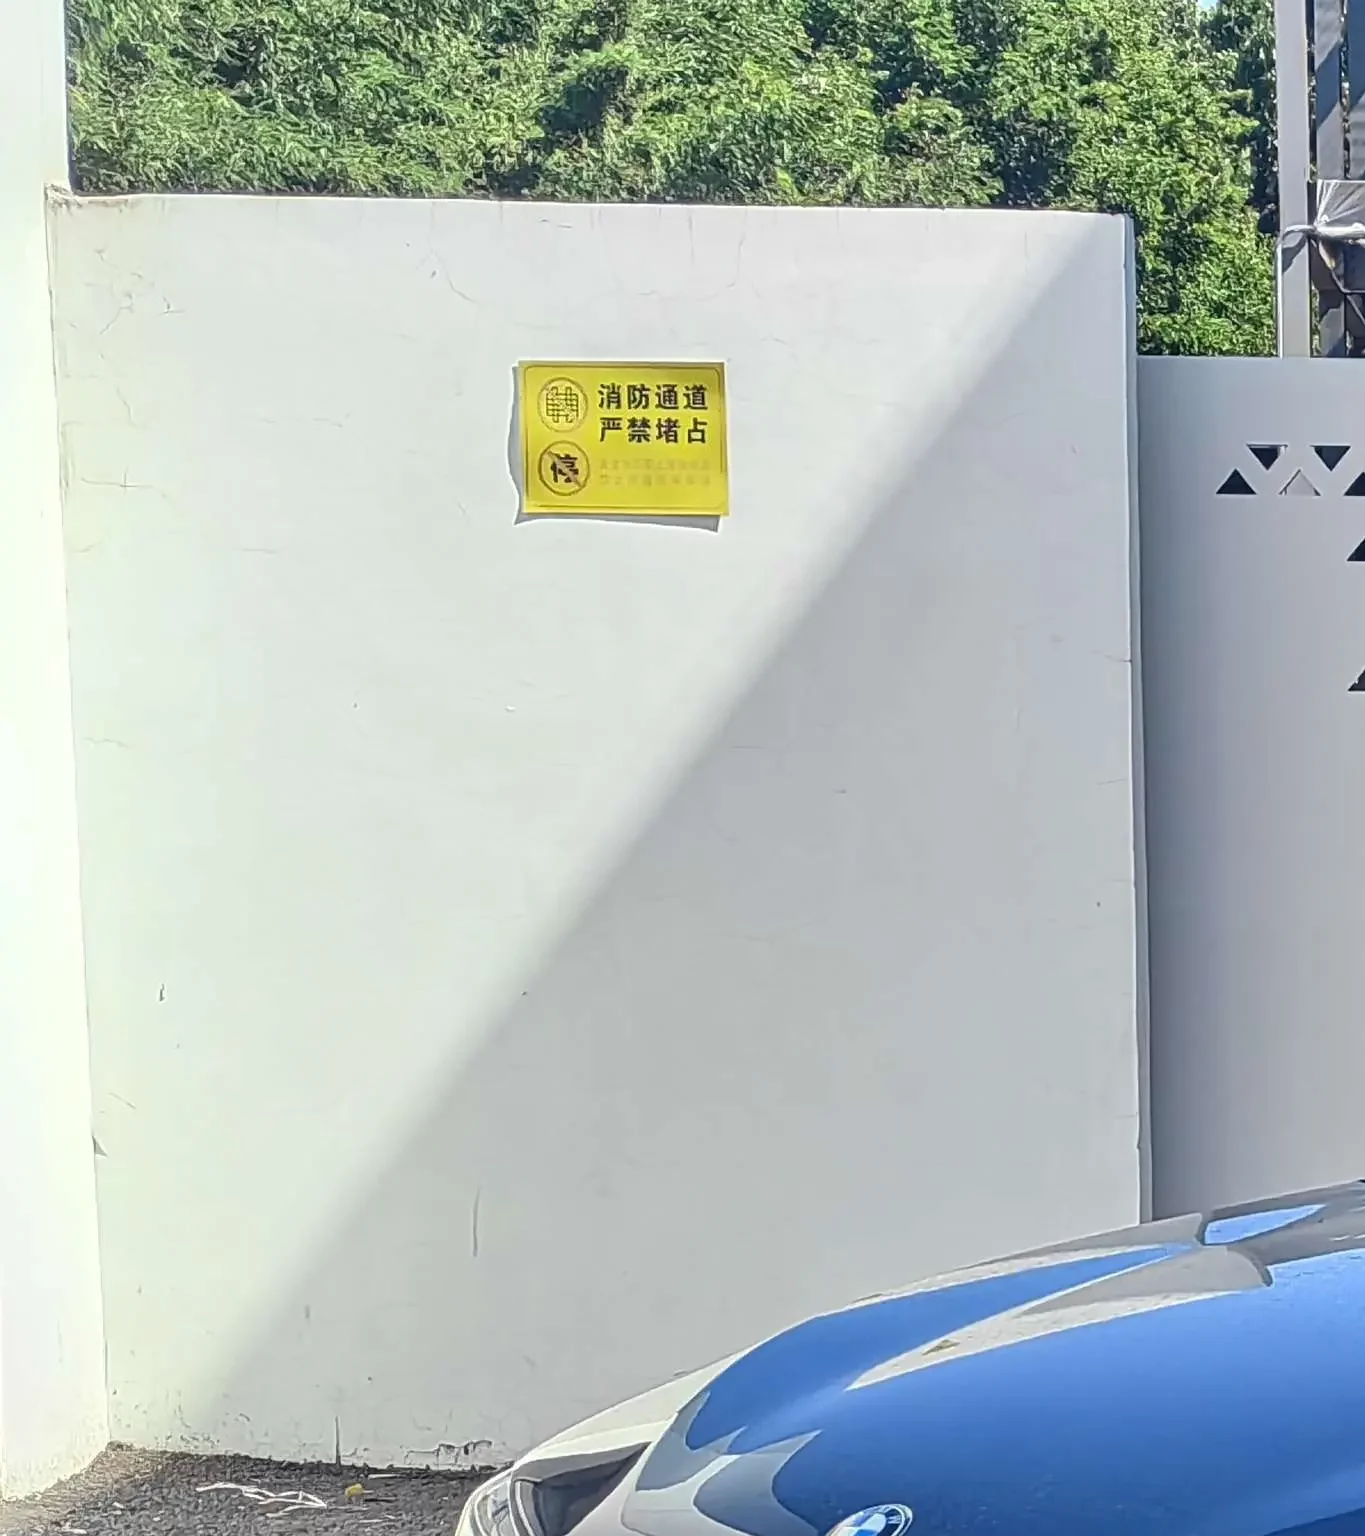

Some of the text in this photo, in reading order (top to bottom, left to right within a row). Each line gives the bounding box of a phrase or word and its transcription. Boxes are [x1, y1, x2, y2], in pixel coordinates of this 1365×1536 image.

[598, 382, 708, 410] 消防通道
[599, 417, 708, 443] 严禁堵占
